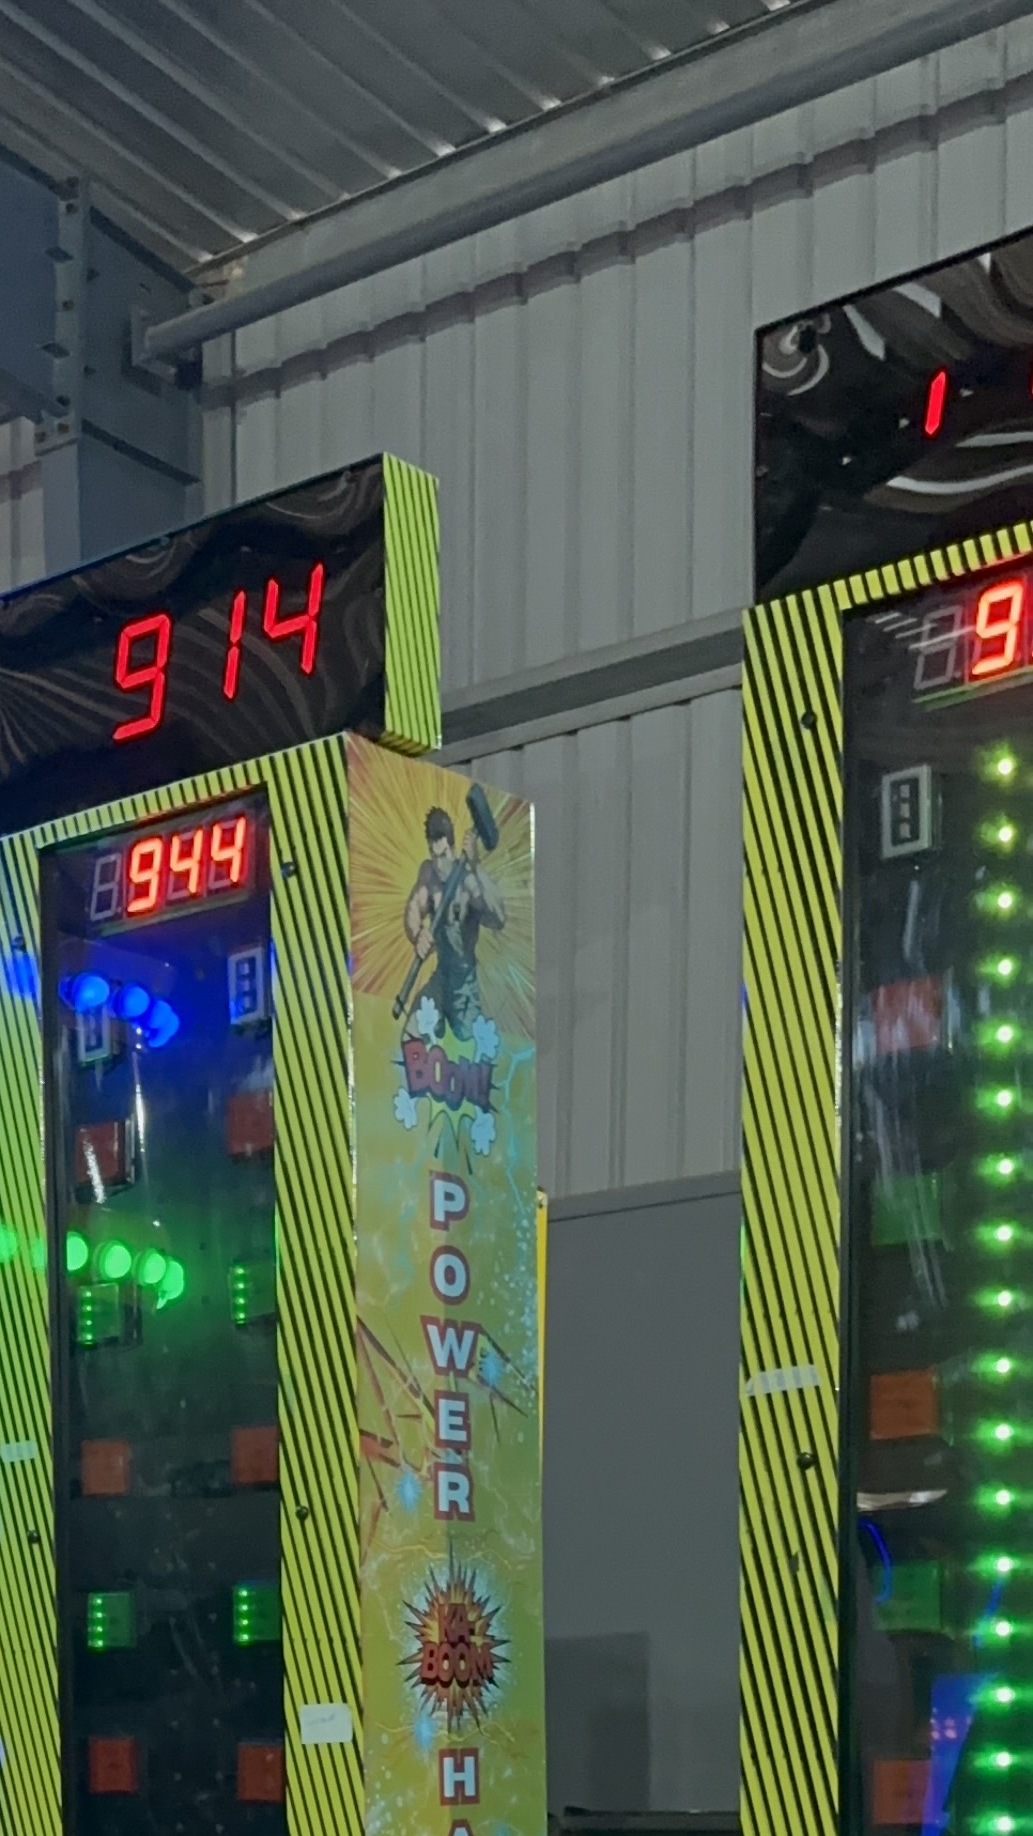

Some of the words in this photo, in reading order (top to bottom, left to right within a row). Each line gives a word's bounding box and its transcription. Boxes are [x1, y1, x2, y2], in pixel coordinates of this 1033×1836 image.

[113, 562, 323, 740] 914
[127, 815, 247, 913] 944
[423, 1174, 477, 1518] POWER
